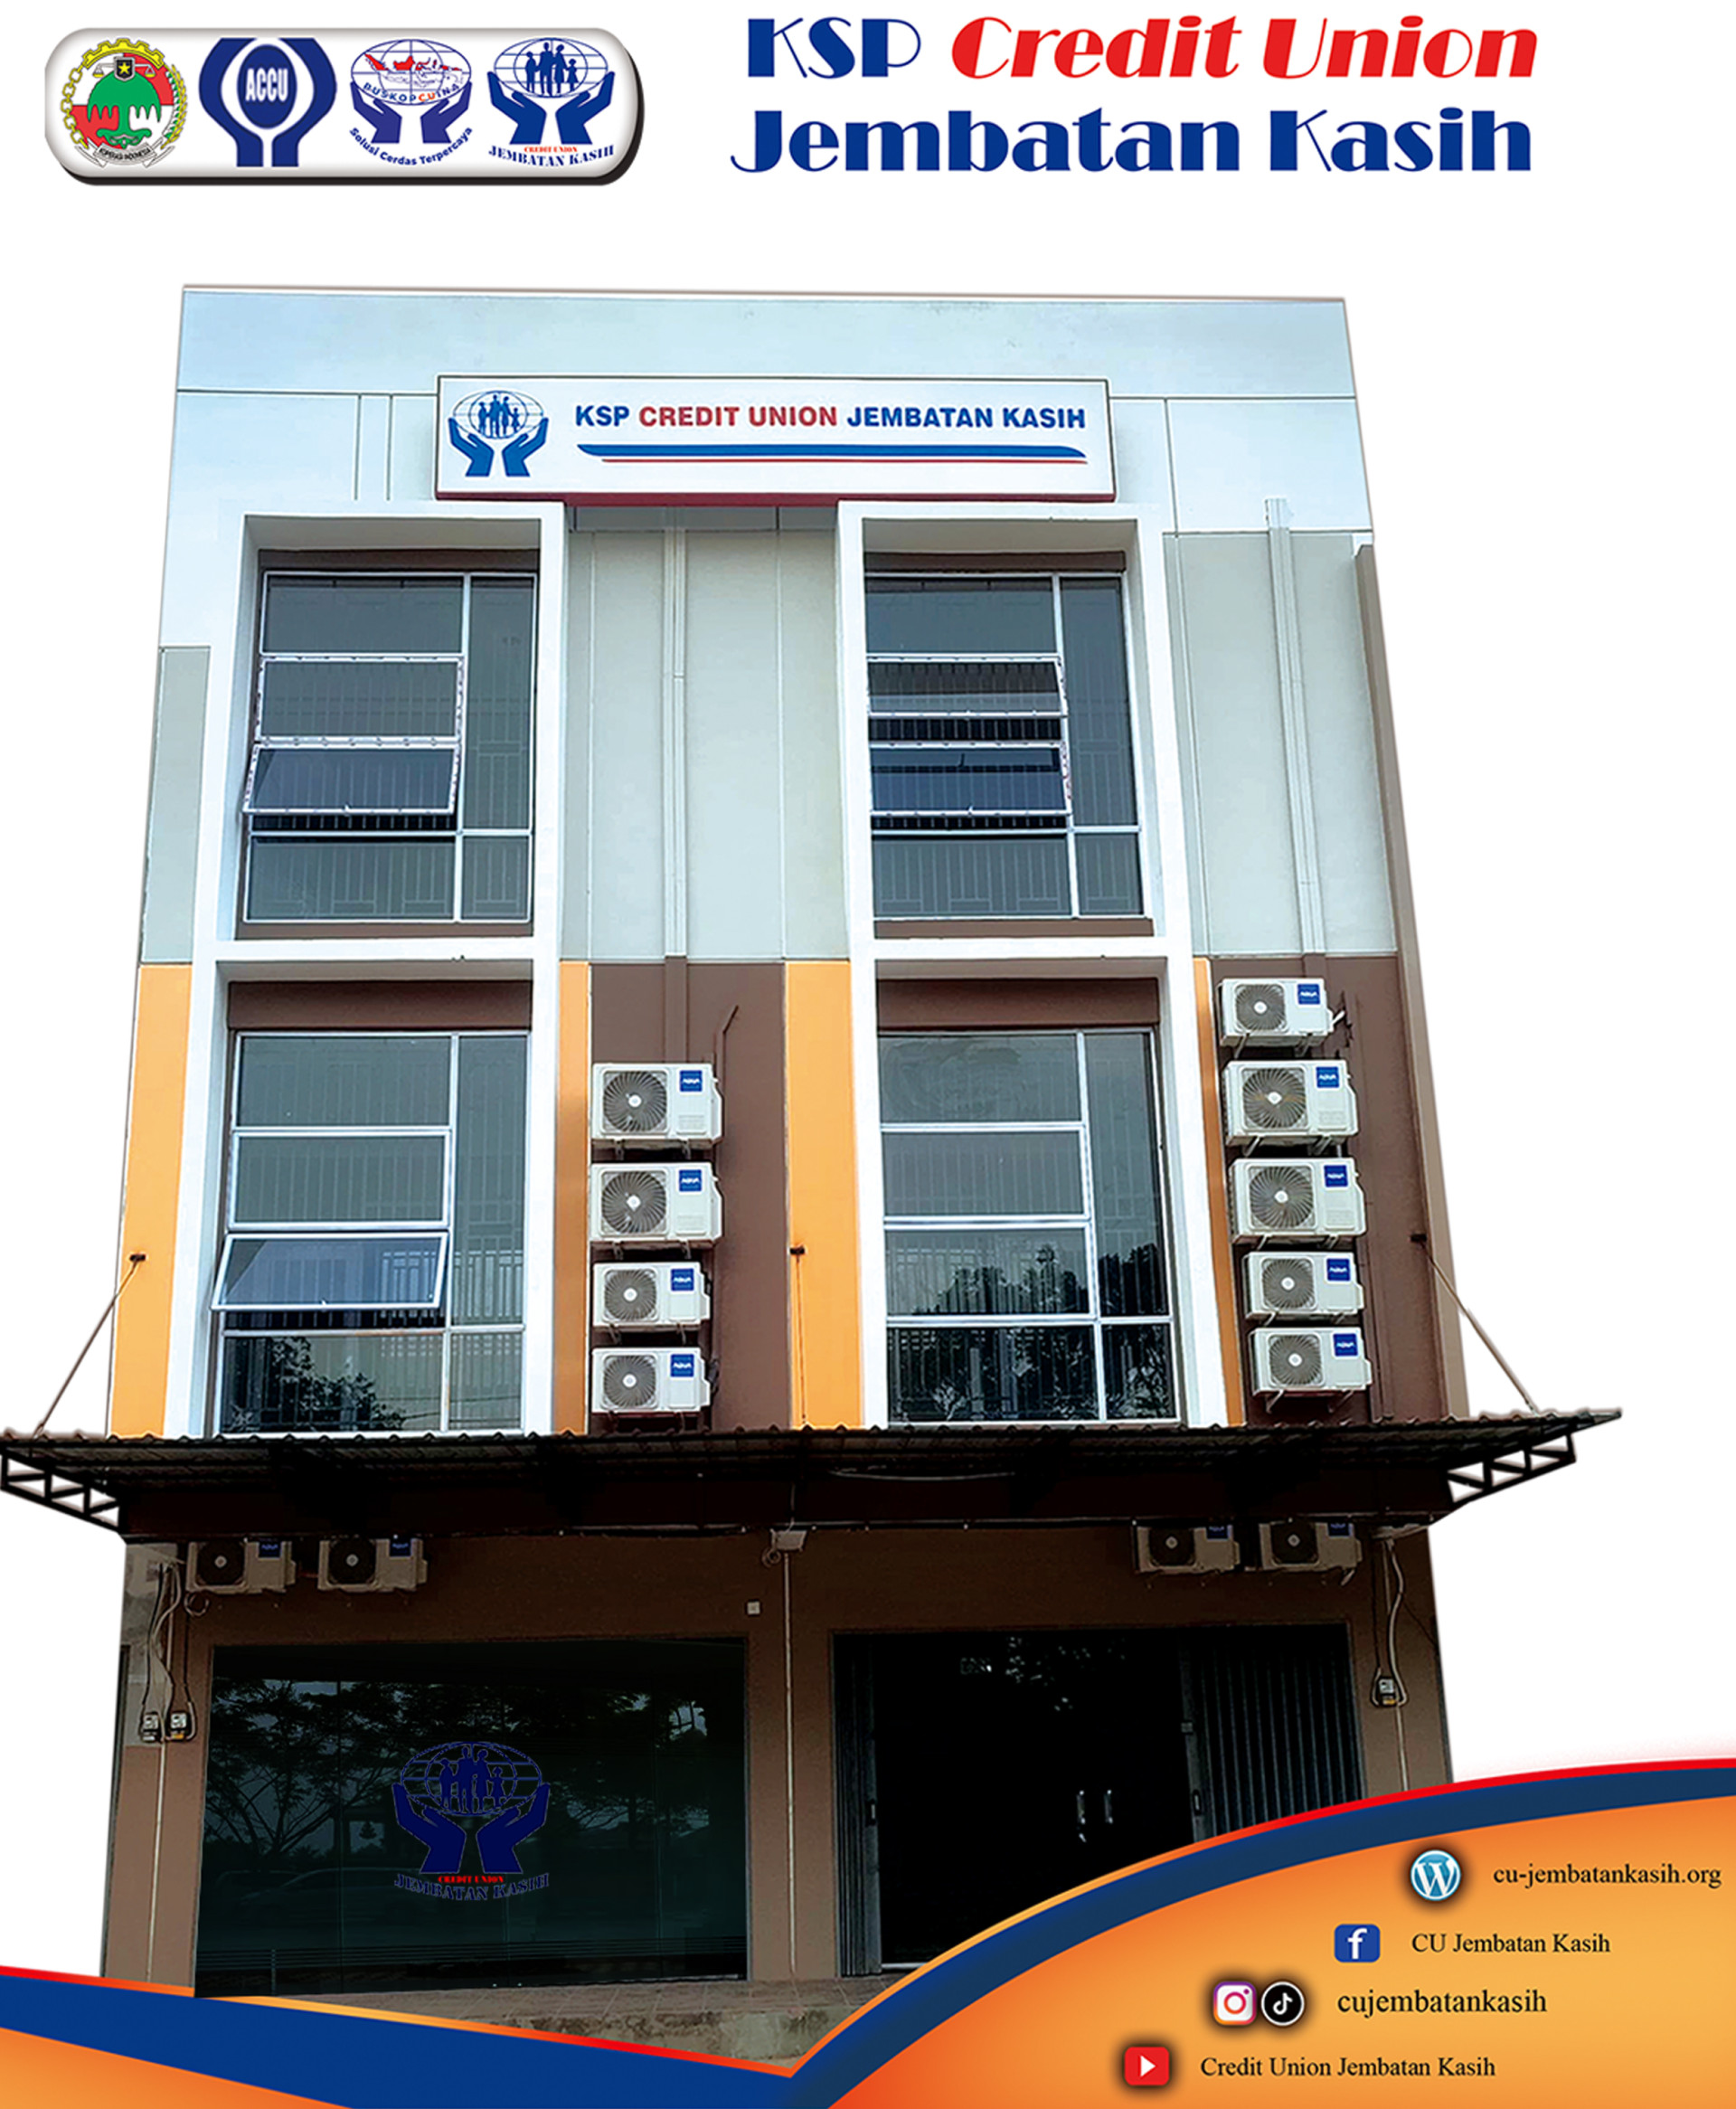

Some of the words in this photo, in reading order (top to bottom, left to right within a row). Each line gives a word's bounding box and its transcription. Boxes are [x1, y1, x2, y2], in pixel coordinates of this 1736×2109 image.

[575, 405, 630, 427] KSP
[639, 406, 740, 427] CREDIT
[750, 406, 838, 427] UNION
[847, 406, 993, 428] JEMBATAN
[1003, 407, 1086, 429] KASIH
[394, 1873, 489, 1900] JEMBATAN
[493, 1872, 550, 1899] KASIH
